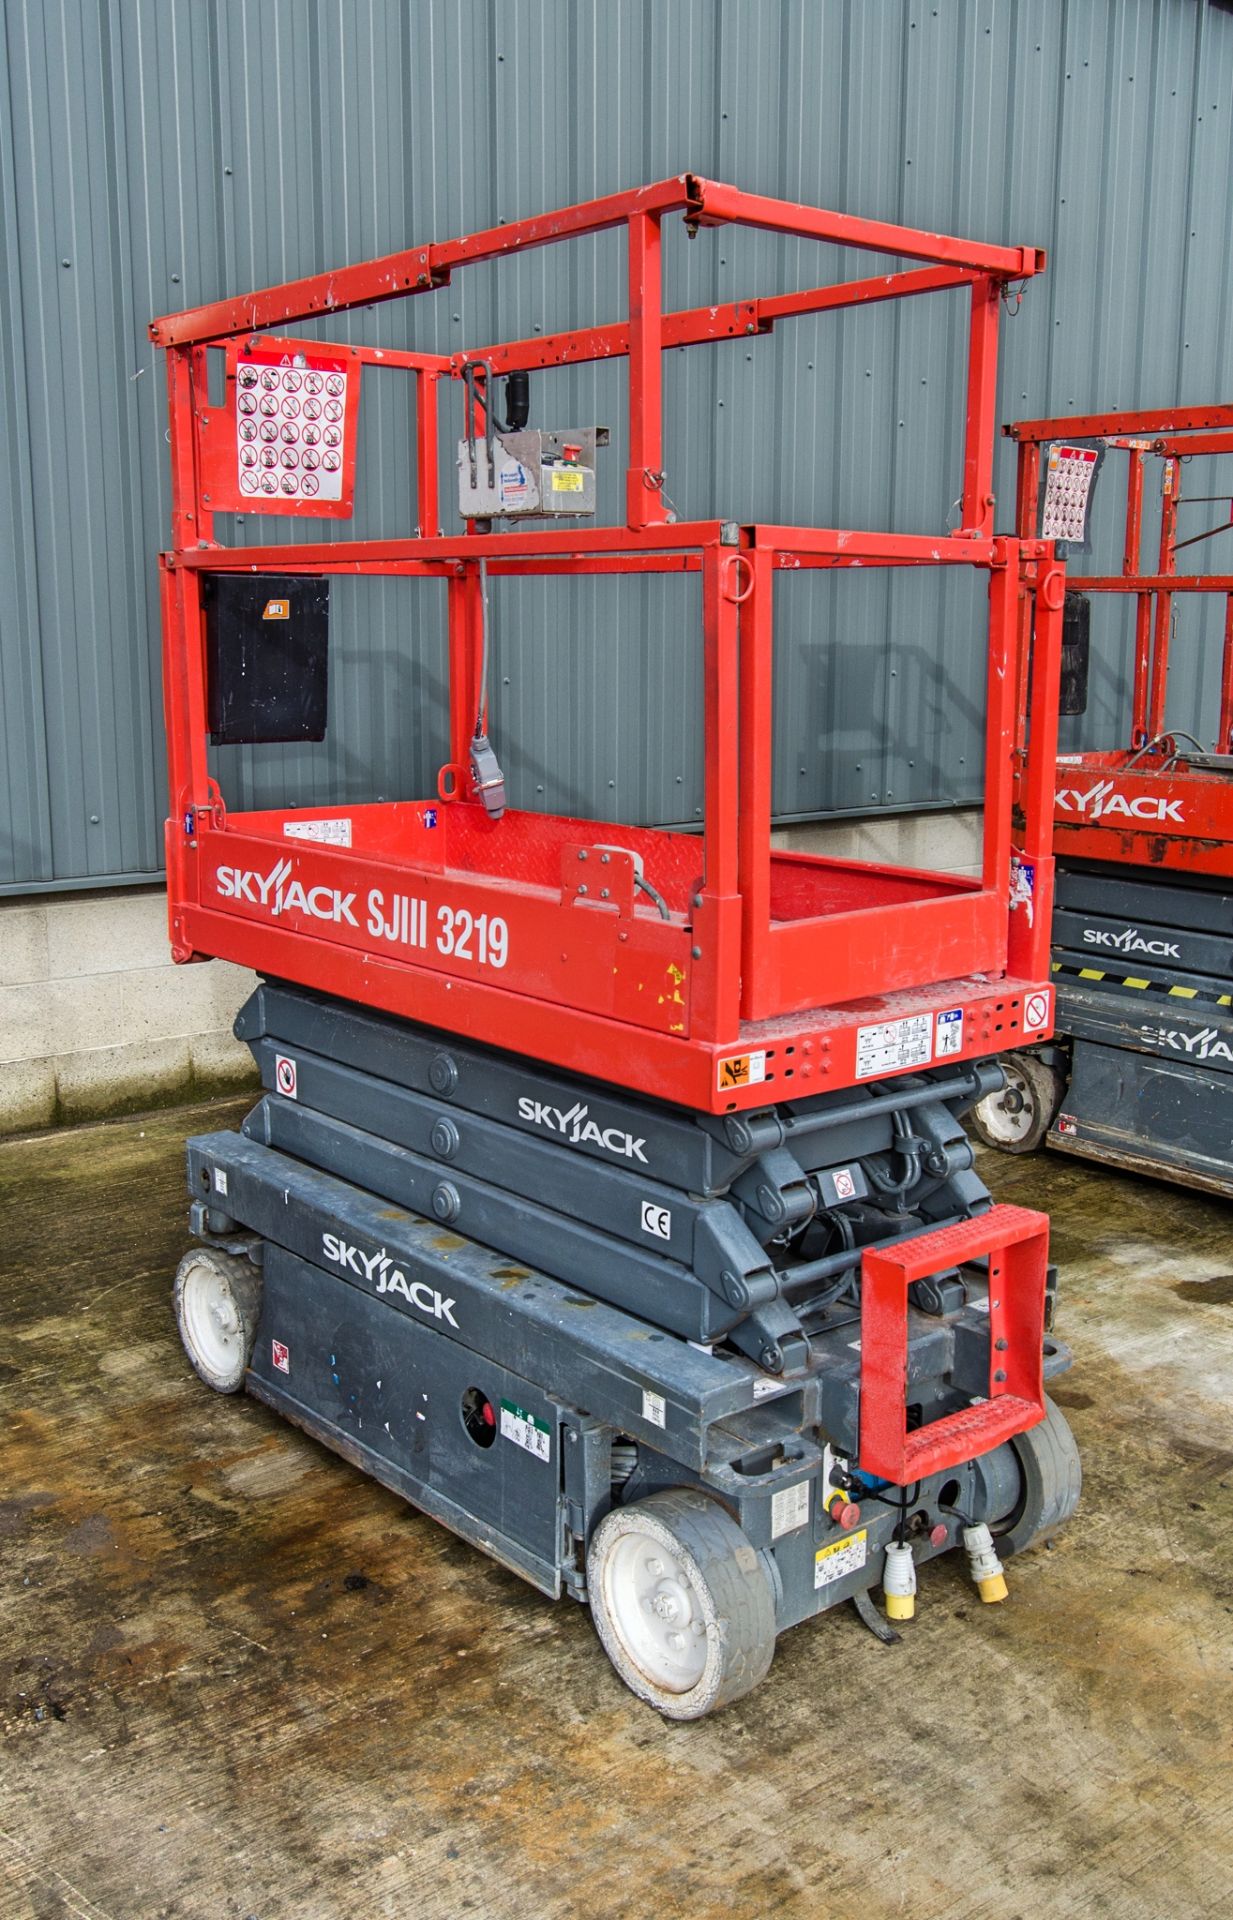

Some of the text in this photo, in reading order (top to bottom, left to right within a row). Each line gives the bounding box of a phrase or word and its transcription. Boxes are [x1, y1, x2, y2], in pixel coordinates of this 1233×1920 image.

[1053, 780, 1185, 822] KYJACK
[216, 857, 509, 969] SKYJACK SJIII 3219
[1083, 928, 1181, 959] SKYJACK
[1140, 1027, 1233, 1062] SKYJA
[518, 1096, 649, 1164] SKYJACK
[644, 1204, 669, 1237] CE
[322, 1233, 460, 1329] SKYJACK
